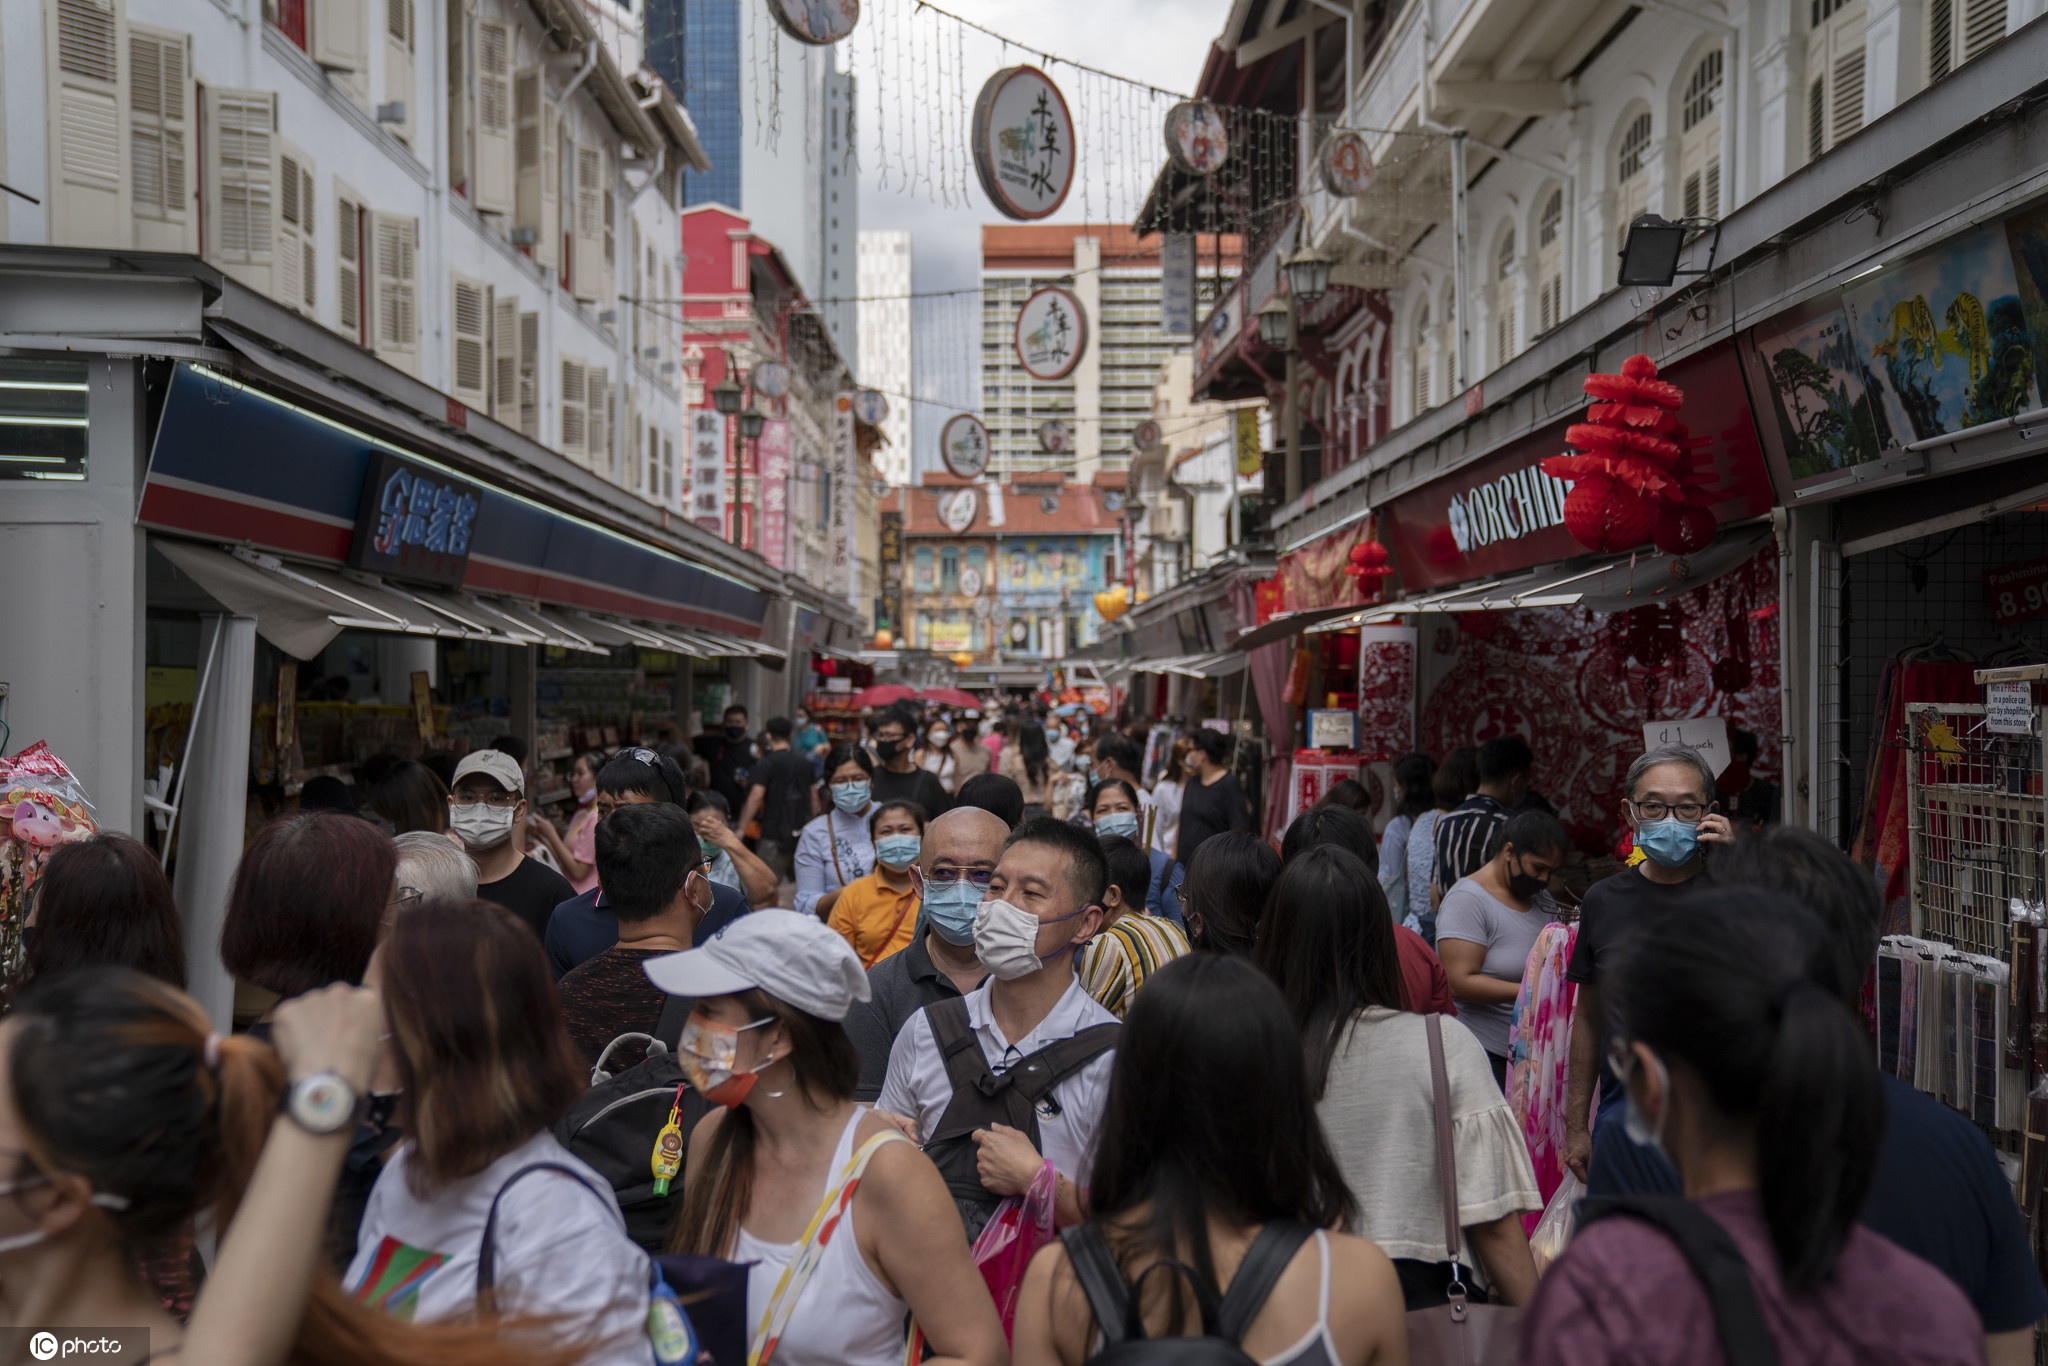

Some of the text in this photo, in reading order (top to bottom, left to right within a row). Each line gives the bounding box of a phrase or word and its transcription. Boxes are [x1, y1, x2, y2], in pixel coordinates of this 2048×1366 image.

[1031, 87, 1061, 201] 牛车水
[1989, 564, 2048, 587] Pashmina
[2005, 682, 2019, 692] FREE
[1993, 694, 1998, 703] in
[2002, 694, 2017, 705] police
[1997, 706, 2003, 716] by
[1991, 716, 2026, 727] from this store
